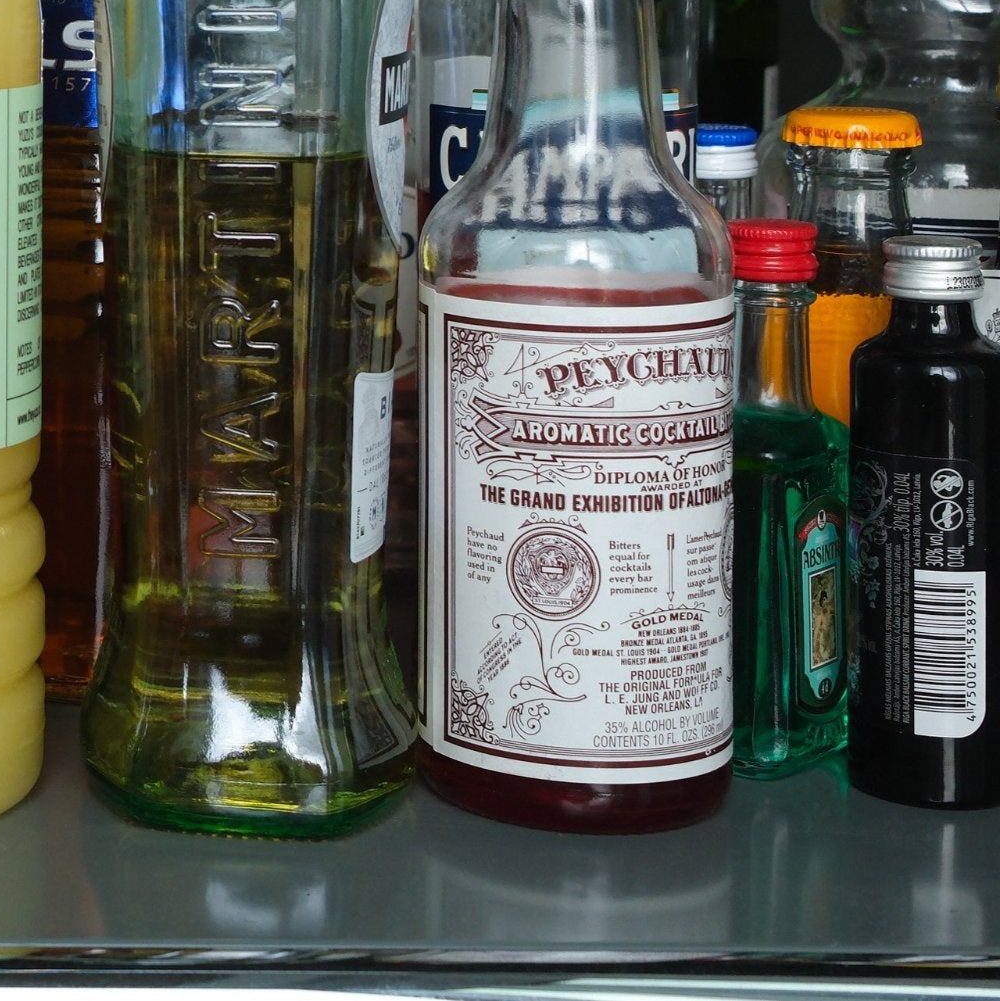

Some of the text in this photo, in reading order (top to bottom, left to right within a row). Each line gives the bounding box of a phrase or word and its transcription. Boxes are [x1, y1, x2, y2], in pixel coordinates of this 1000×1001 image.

[512, 415, 719, 447] AROMATIC COCKTAIL
[594, 459, 726, 485] DIPLOMA OF HONOR
[640, 479, 703, 493] AWARDED AT
[480, 483, 685, 514] THE GRAND EXHIBITION OF
[966, 479, 976, 547] www.RigaBlack.com
[466, 526, 505, 542] Peychaud
[467, 538, 498, 551] have no
[609, 540, 641, 550] Bitters
[925, 530, 943, 567] 30% vol.
[467, 547, 503, 565] flavoring
[609, 551, 651, 563] equal for
[946, 544, 965, 568] 0.04L
[467, 560, 485, 571] used
[609, 562, 652, 573] cocktails
[476, 574, 492, 584] any
[609, 573, 653, 585] every bar
[610, 585, 658, 596] prominence
[631, 611, 704, 630] GOLD MEDAL
[964, 589, 977, 644] 538995
[638, 628, 677, 638] NEW ORLEANS
[620, 635, 689, 648] BRONZE MEDAL ATLANTA,
[572, 648, 645, 657] GOLD MEDAL LOUIS
[620, 657, 646, 666] HIGHEST
[630, 661, 707, 681] PRODUCED FROM
[600, 682, 620, 693] THE
[623, 678, 671, 693] ORIGINAL
[711, 666, 723, 679] FOR
[964, 653, 977, 708] 750021
[632, 689, 681, 704] JUNG AND
[625, 699, 692, 715] NEW ORLEANS,
[604, 707, 720, 735] 35% ALCOHOL BY VOLUME
[593, 728, 699, 749] CONTENTS 10 FL. OZS.
